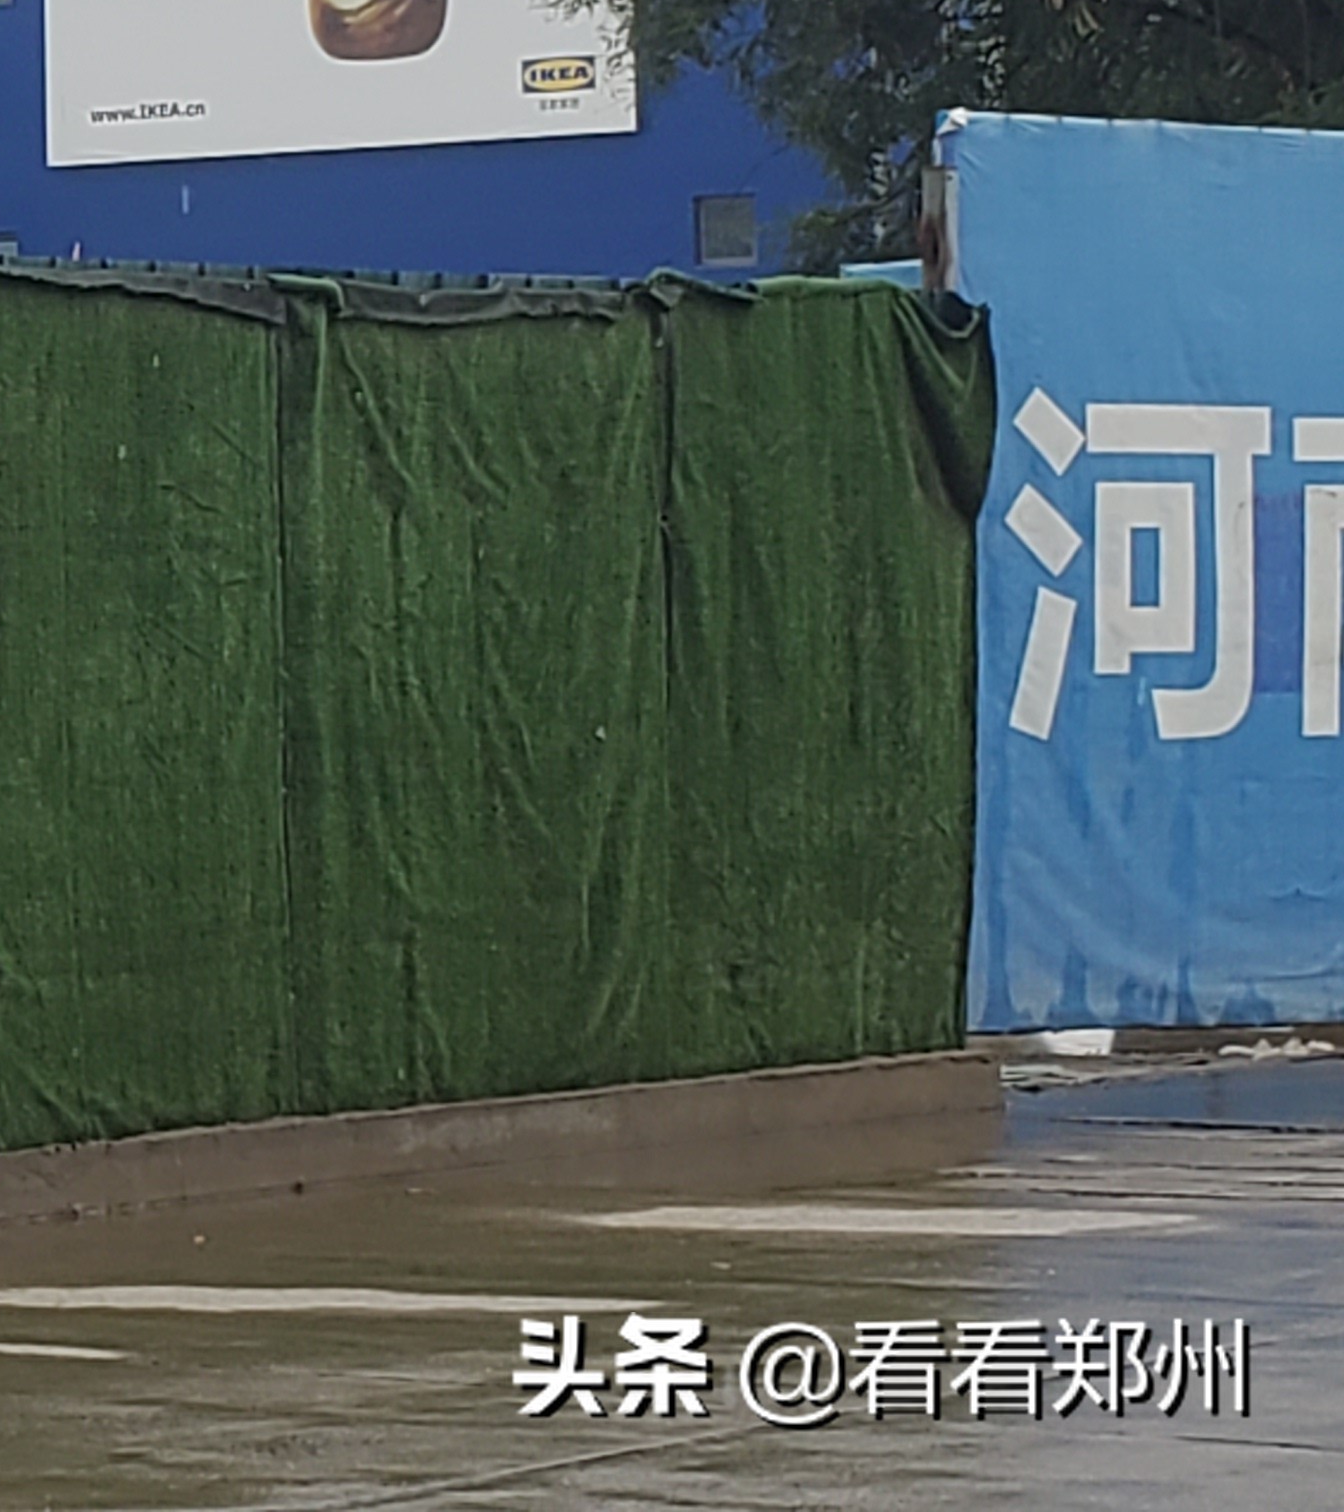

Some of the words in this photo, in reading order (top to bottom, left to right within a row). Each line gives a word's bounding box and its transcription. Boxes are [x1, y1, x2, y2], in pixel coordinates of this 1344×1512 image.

[530, 66, 589, 82] IKEA
[91, 102, 206, 122] www.IKEA.cn
[1004, 386, 1344, 740] 河
